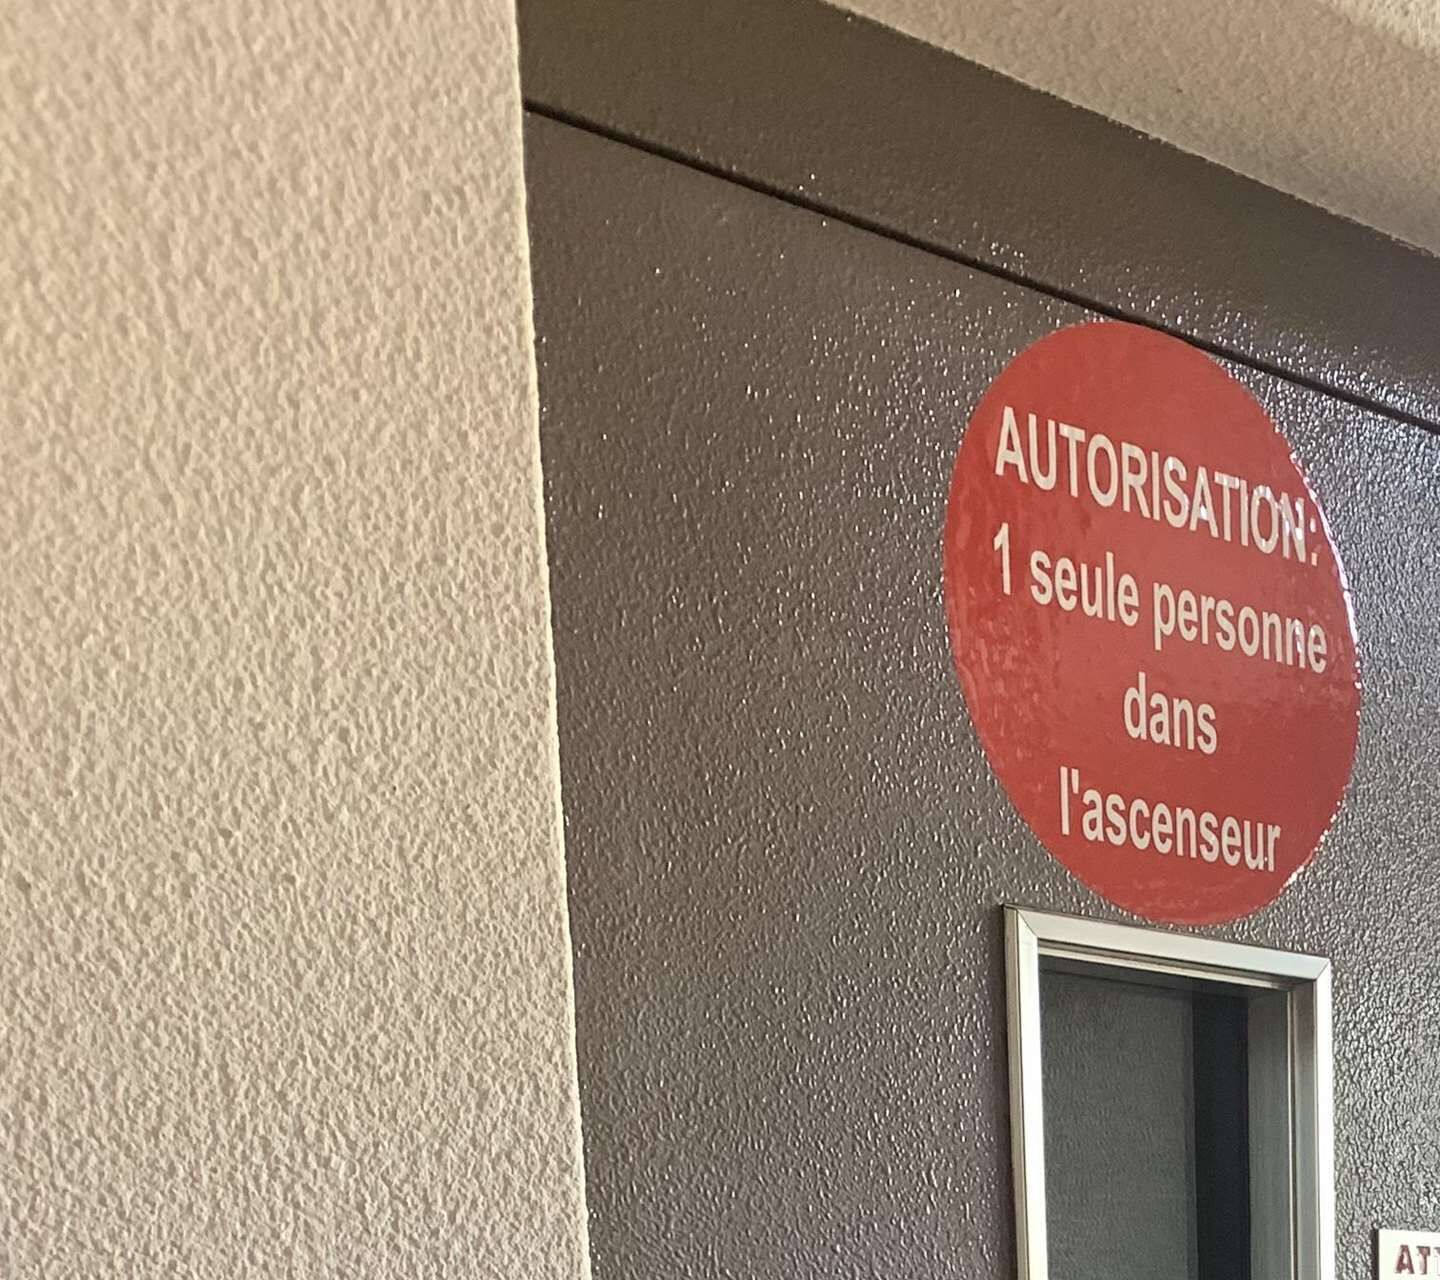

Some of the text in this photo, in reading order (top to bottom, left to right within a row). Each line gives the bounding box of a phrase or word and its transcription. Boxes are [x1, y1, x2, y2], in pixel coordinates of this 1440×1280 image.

[995, 406, 1319, 566] AUTORISATION:
[993, 523, 1328, 674] 1 seule personne
[1123, 671, 1218, 755] dans
[1059, 766, 1281, 873] l'ascenseur
